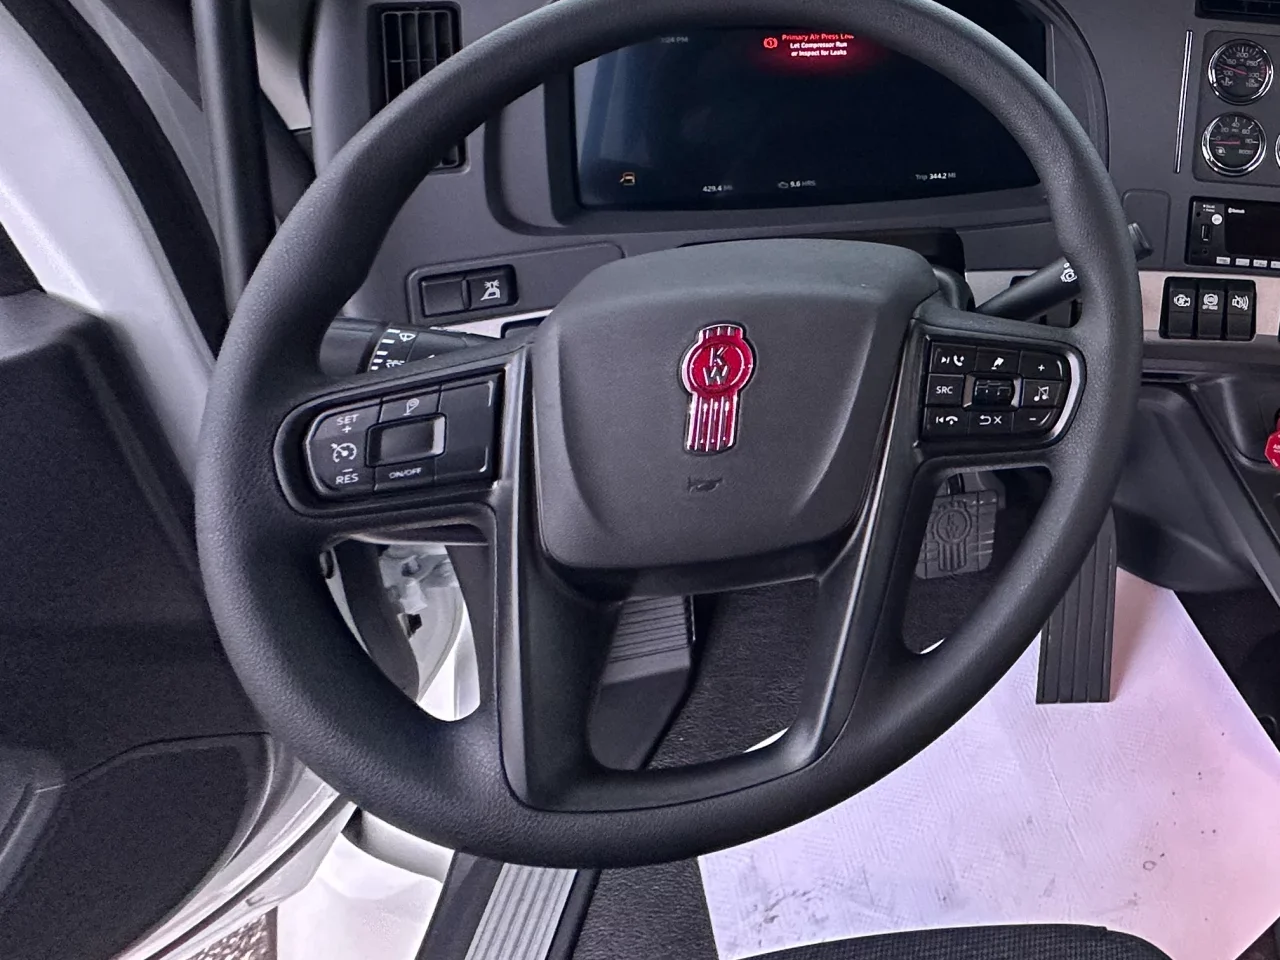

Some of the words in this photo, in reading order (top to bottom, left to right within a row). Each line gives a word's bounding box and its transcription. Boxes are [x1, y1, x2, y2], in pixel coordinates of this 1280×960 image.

[936, 386, 954, 394] SRC
[336, 414, 360, 425] SET
[389, 468, 422, 479] ON/OFF
[336, 474, 359, 484] RES
